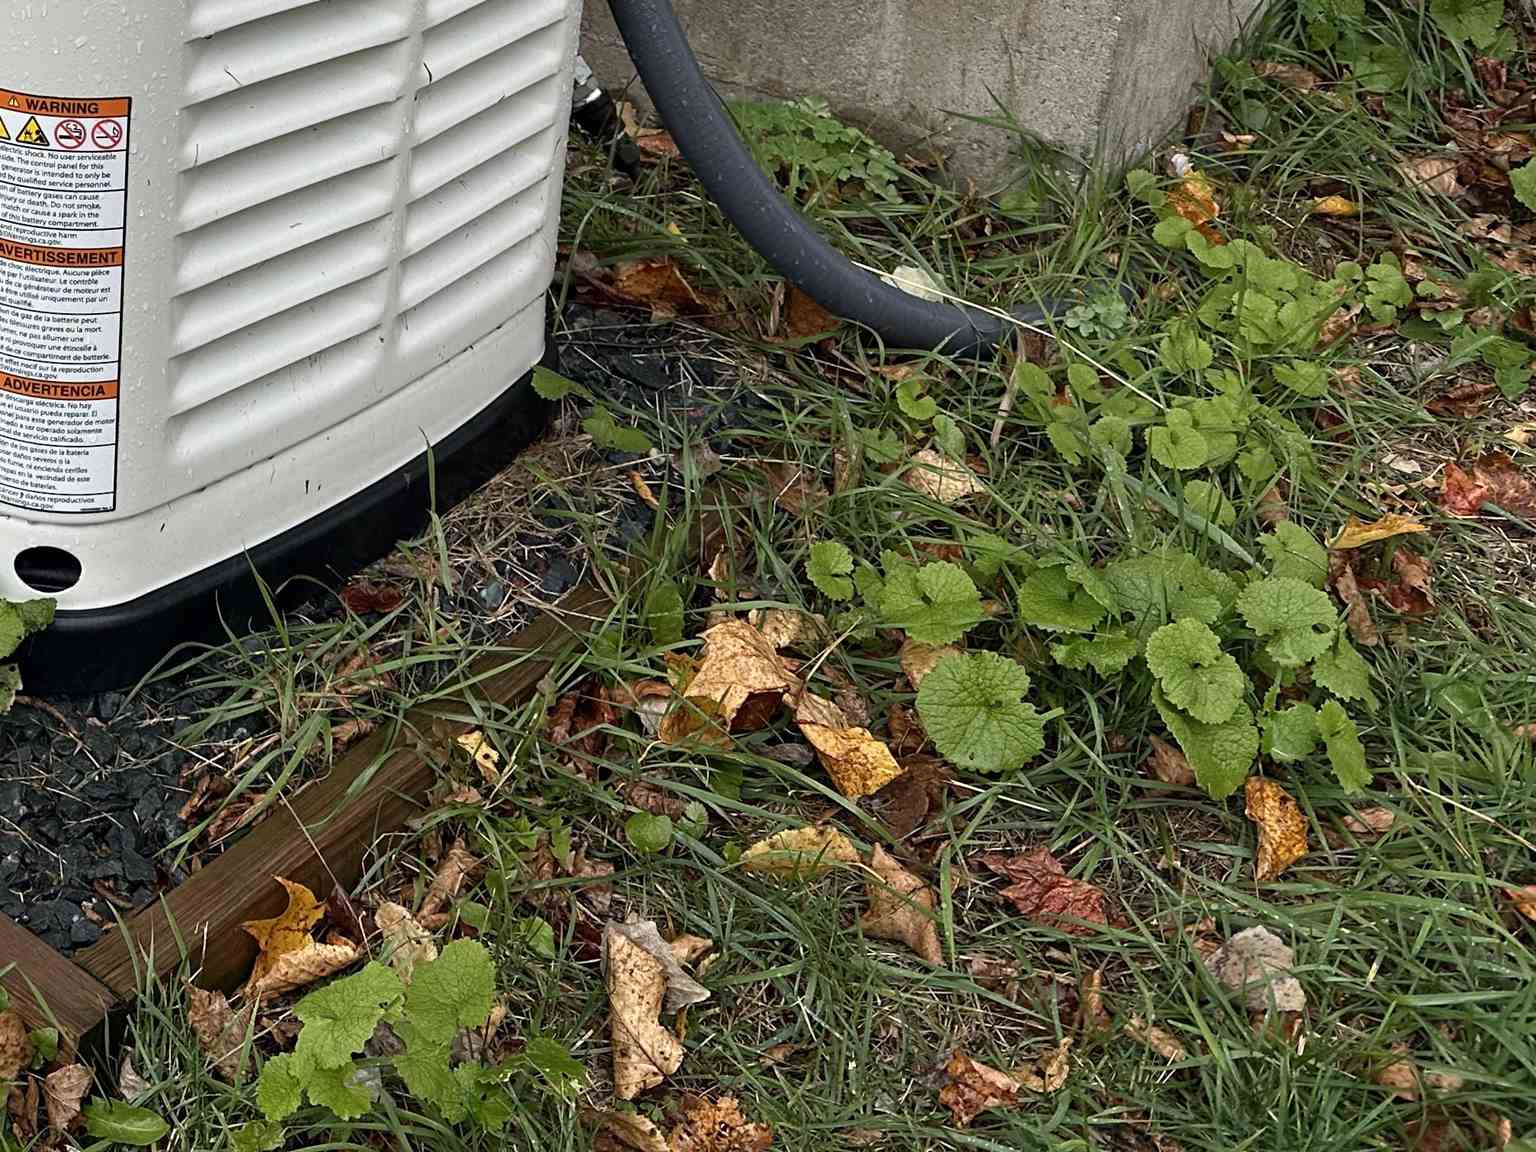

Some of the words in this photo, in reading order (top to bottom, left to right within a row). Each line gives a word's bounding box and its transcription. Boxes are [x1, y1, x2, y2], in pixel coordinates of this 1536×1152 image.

[25, 98, 99, 114] WARNING
[48, 152, 59, 160] No
[18, 156, 29, 165] The
[30, 159, 56, 168] control
[57, 162, 78, 170] panel
[79, 162, 89, 170] for
[90, 162, 104, 170] this
[34, 168, 40, 176] is
[42, 170, 74, 178] intended
[84, 172, 100, 180] only
[8, 173, 16, 181] by
[16, 176, 46, 186] qualified
[48, 180, 74, 188] service
[42, 192, 63, 200] gases
[51, 200, 61, 208] Do
[30, 208, 51, 216] cause
[58, 210, 78, 219] spark
[9, 212, 22, 221] this
[22, 216, 46, 226] battery
[14, 226, 58, 238] reproductive
[62, 269, 90, 277] Aucune
[62, 286, 72, 294] de
[84, 296, 98, 304] par
[34, 314, 43, 322] de
[52, 316, 80, 324] batterie
[80, 317, 98, 325] peut
[76, 326, 83, 334] la
[58, 366, 104, 374] reproduction
[3, 376, 106, 397] ADVERTENCIA
[79, 402, 92, 410] hay
[40, 410, 62, 418] pueda
[46, 418, 84, 426] generador
[84, 418, 94, 426] de
[94, 418, 115, 426] motor
[36, 426, 66, 434] operado
[48, 448, 58, 456] de
[58, 448, 65, 456] la
[32, 456, 58, 464] severos
[34, 466, 64, 474] encienda
[36, 474, 66, 482] vecindad
[47, 496, 95, 504] reproductivos
